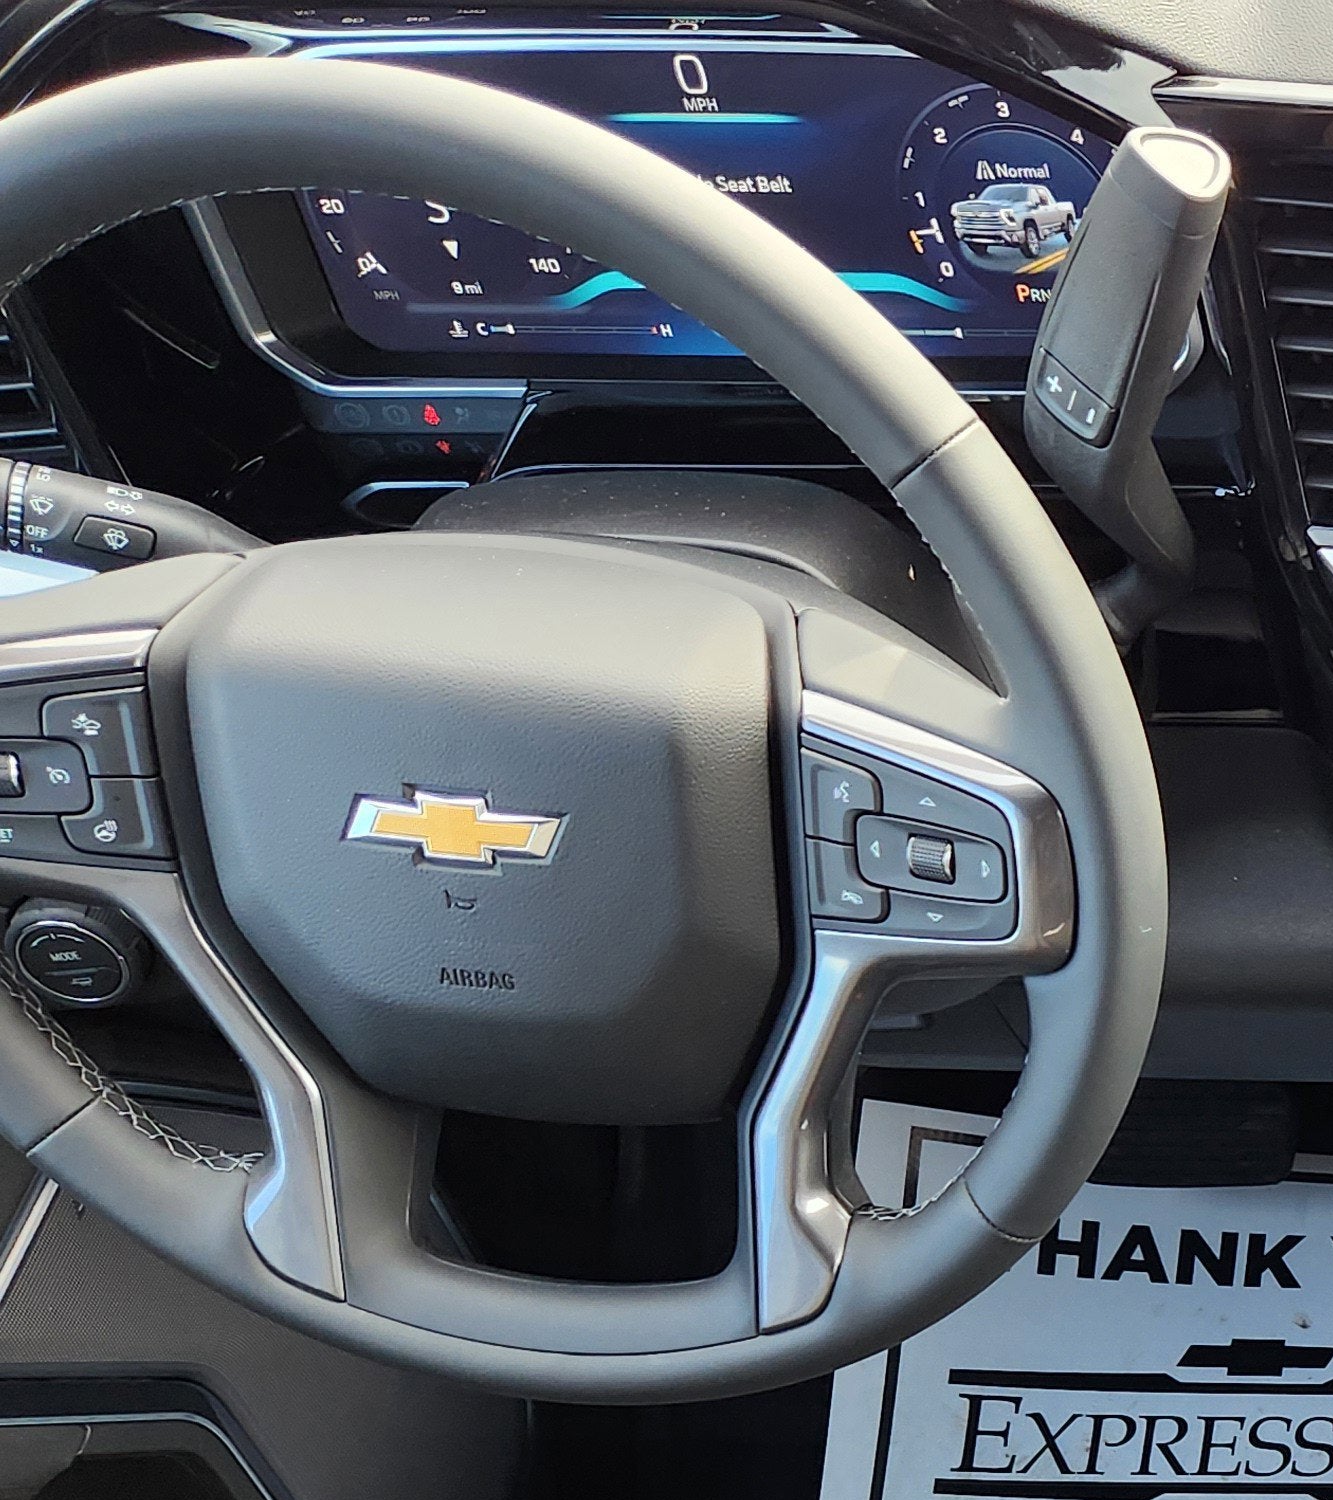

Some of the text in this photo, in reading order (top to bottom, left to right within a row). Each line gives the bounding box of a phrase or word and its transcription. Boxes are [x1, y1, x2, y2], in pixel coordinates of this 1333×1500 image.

[673, 53, 708, 95] 0
[682, 97, 719, 112] MPH
[995, 101, 1011, 118] 3
[933, 127, 948, 144] 2
[1070, 126, 1085, 145] 4
[995, 163, 1051, 180] Normal
[715, 174, 757, 194] Seat
[757, 174, 793, 194] Belt
[318, 198, 345, 215] 20
[528, 257, 562, 275] 140
[939, 261, 955, 278] 0
[373, 289, 400, 301] MPH
[450, 281, 483, 296] 9 mi
[24, 524, 50, 539] OFF
[0, 827, 14, 839] ET
[50, 950, 82, 962] MODE
[439, 966, 516, 991] AIRBAG
[1036, 1217, 1302, 1289] HANK
